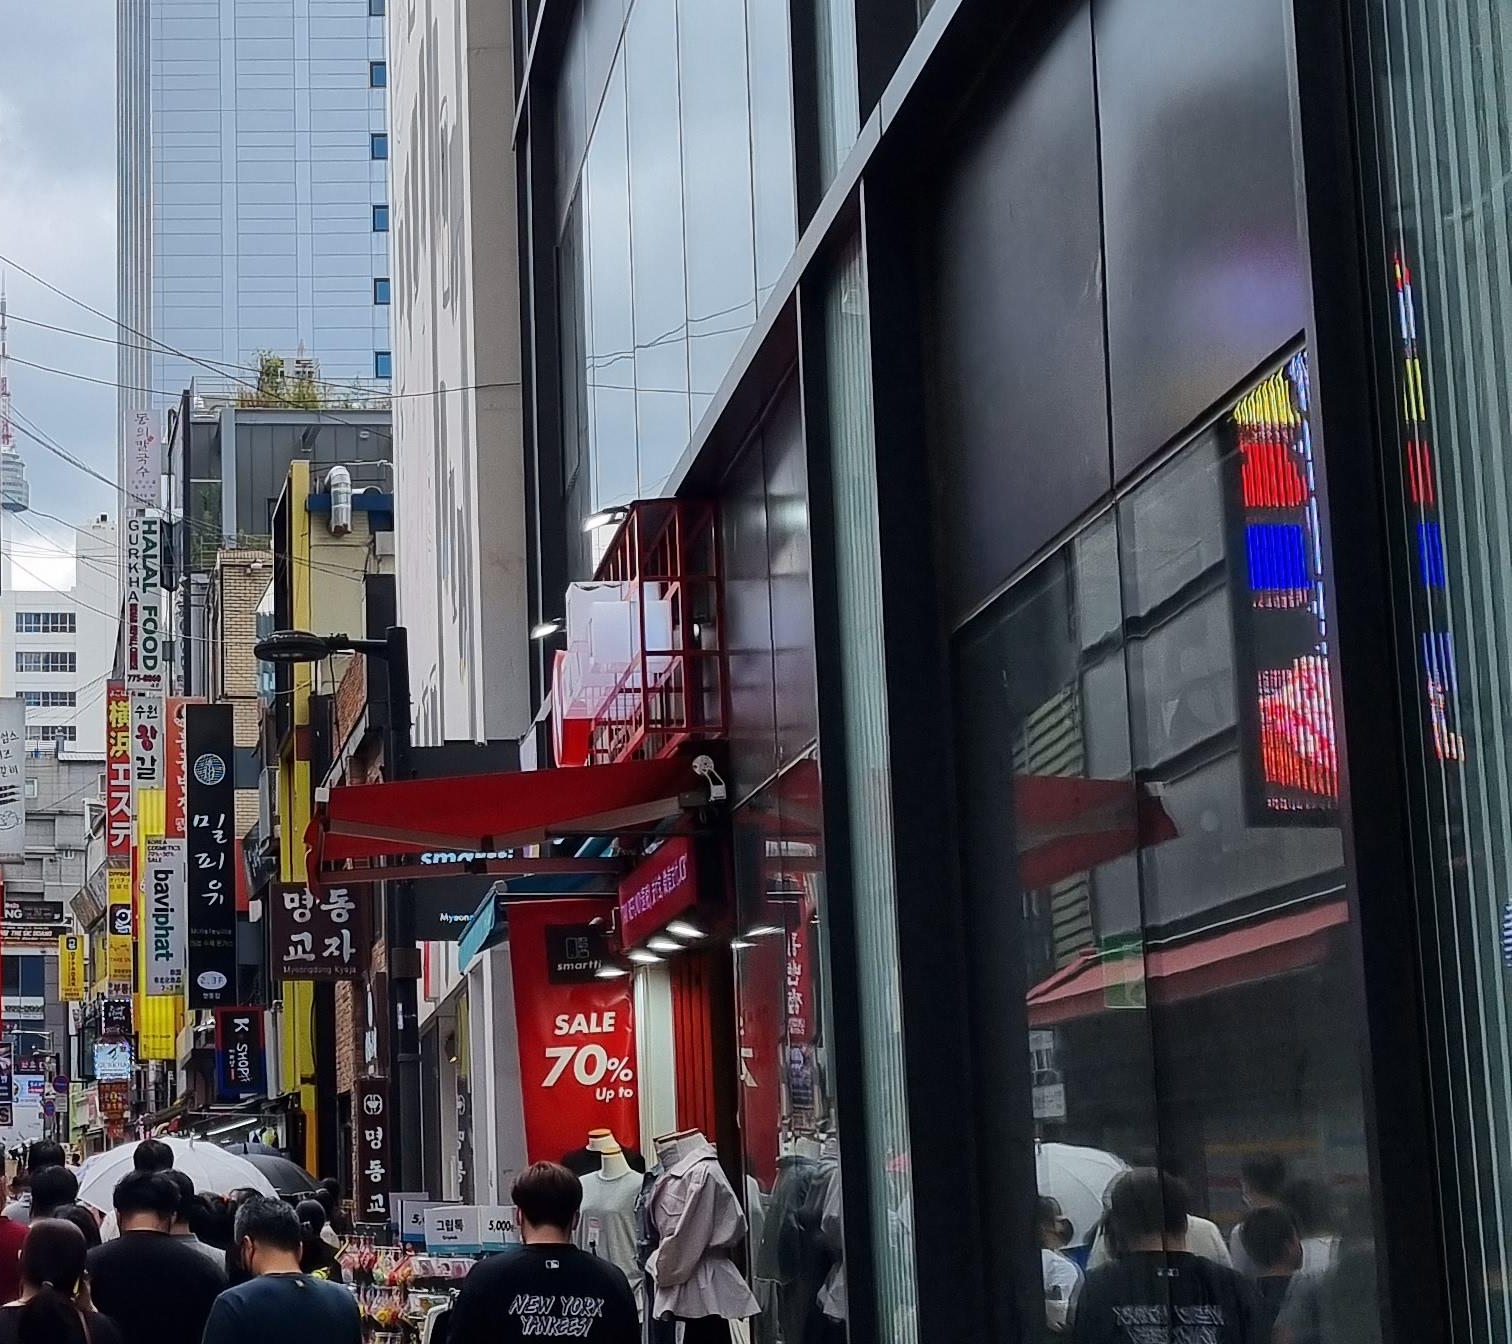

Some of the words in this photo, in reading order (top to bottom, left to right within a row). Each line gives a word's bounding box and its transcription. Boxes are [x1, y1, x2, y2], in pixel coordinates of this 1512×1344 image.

[127, 519, 139, 603] GURKHA
[141, 519, 158, 594] HALAL
[141, 605, 158, 672] FOOD
[134, 704, 159, 720] 수원
[153, 868, 175, 962] baviphat
[282, 887, 356, 924] 명동
[282, 929, 357, 964] 교자
[233, 1017, 250, 1034] K
[554, 1011, 617, 1037] SALE
[541, 1044, 634, 1089] 70%
[595, 1086, 616, 1103] Up
[618, 1085, 634, 1100] to
[436, 1218, 465, 1232] 그립톡
[509, 1293, 556, 1315] NEW
[559, 1294, 606, 1318] YORK
